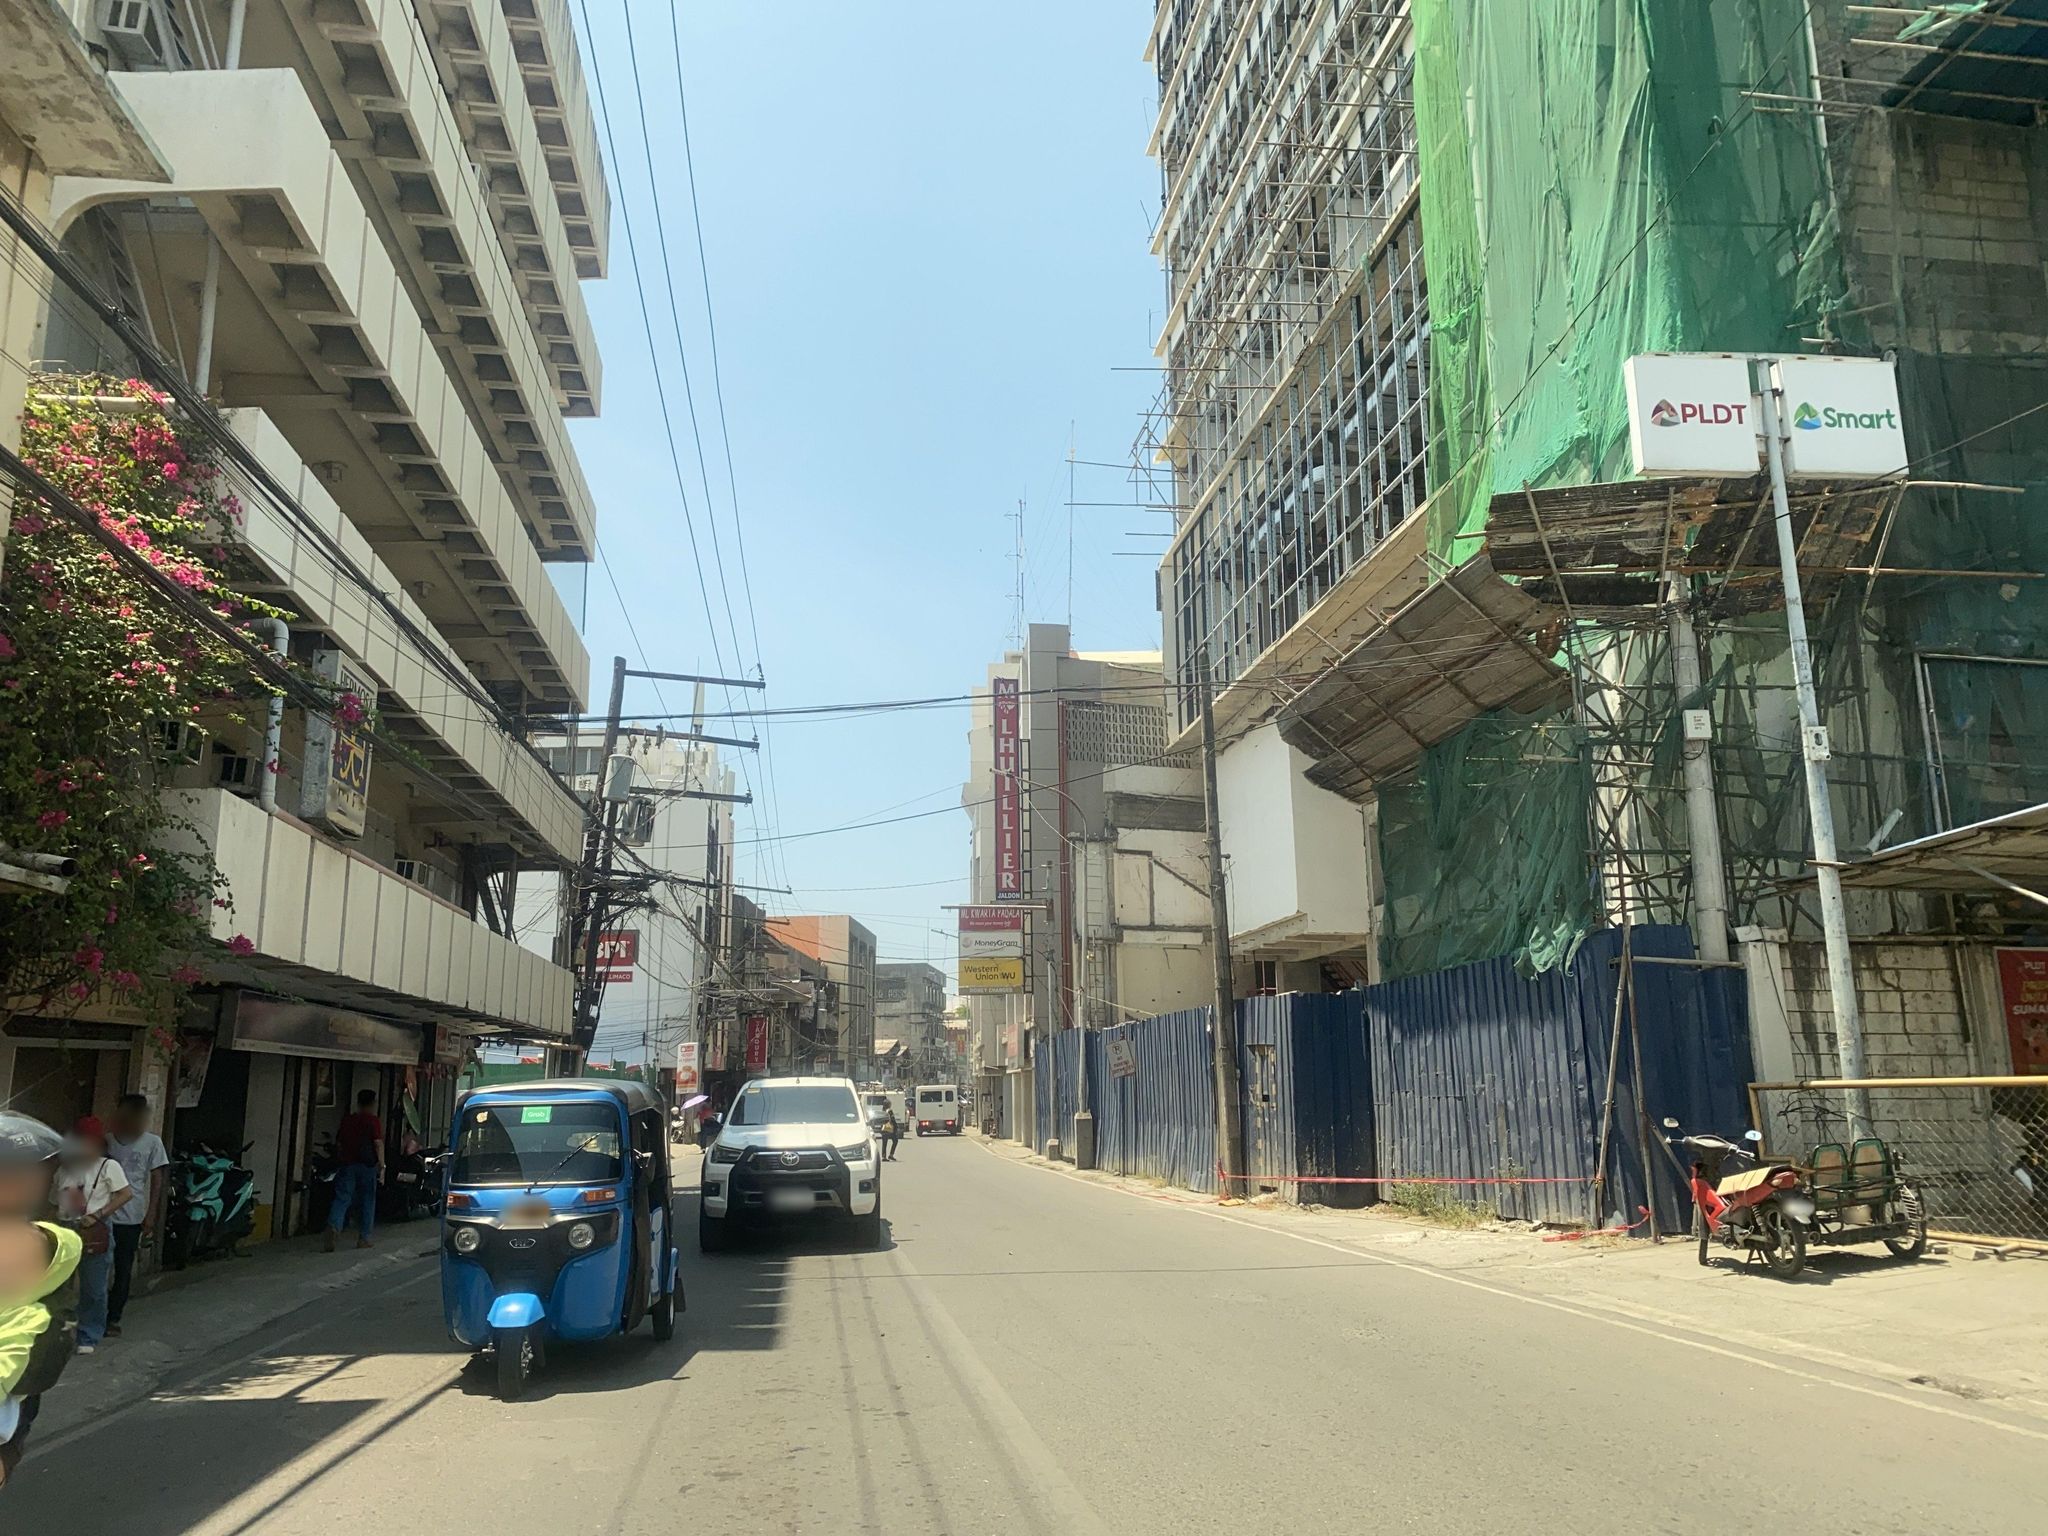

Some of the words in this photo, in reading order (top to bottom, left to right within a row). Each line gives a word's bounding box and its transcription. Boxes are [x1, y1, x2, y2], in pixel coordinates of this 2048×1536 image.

[1681, 402, 1747, 425] PLDT
[1823, 406, 1897, 430] Smart
[999, 718, 1016, 889] LHUILLIER
[596, 940, 627, 959] BPI
[974, 939, 1018, 947] MoneyGram
[964, 966, 998, 974] Western
[975, 972, 999, 981] Union
